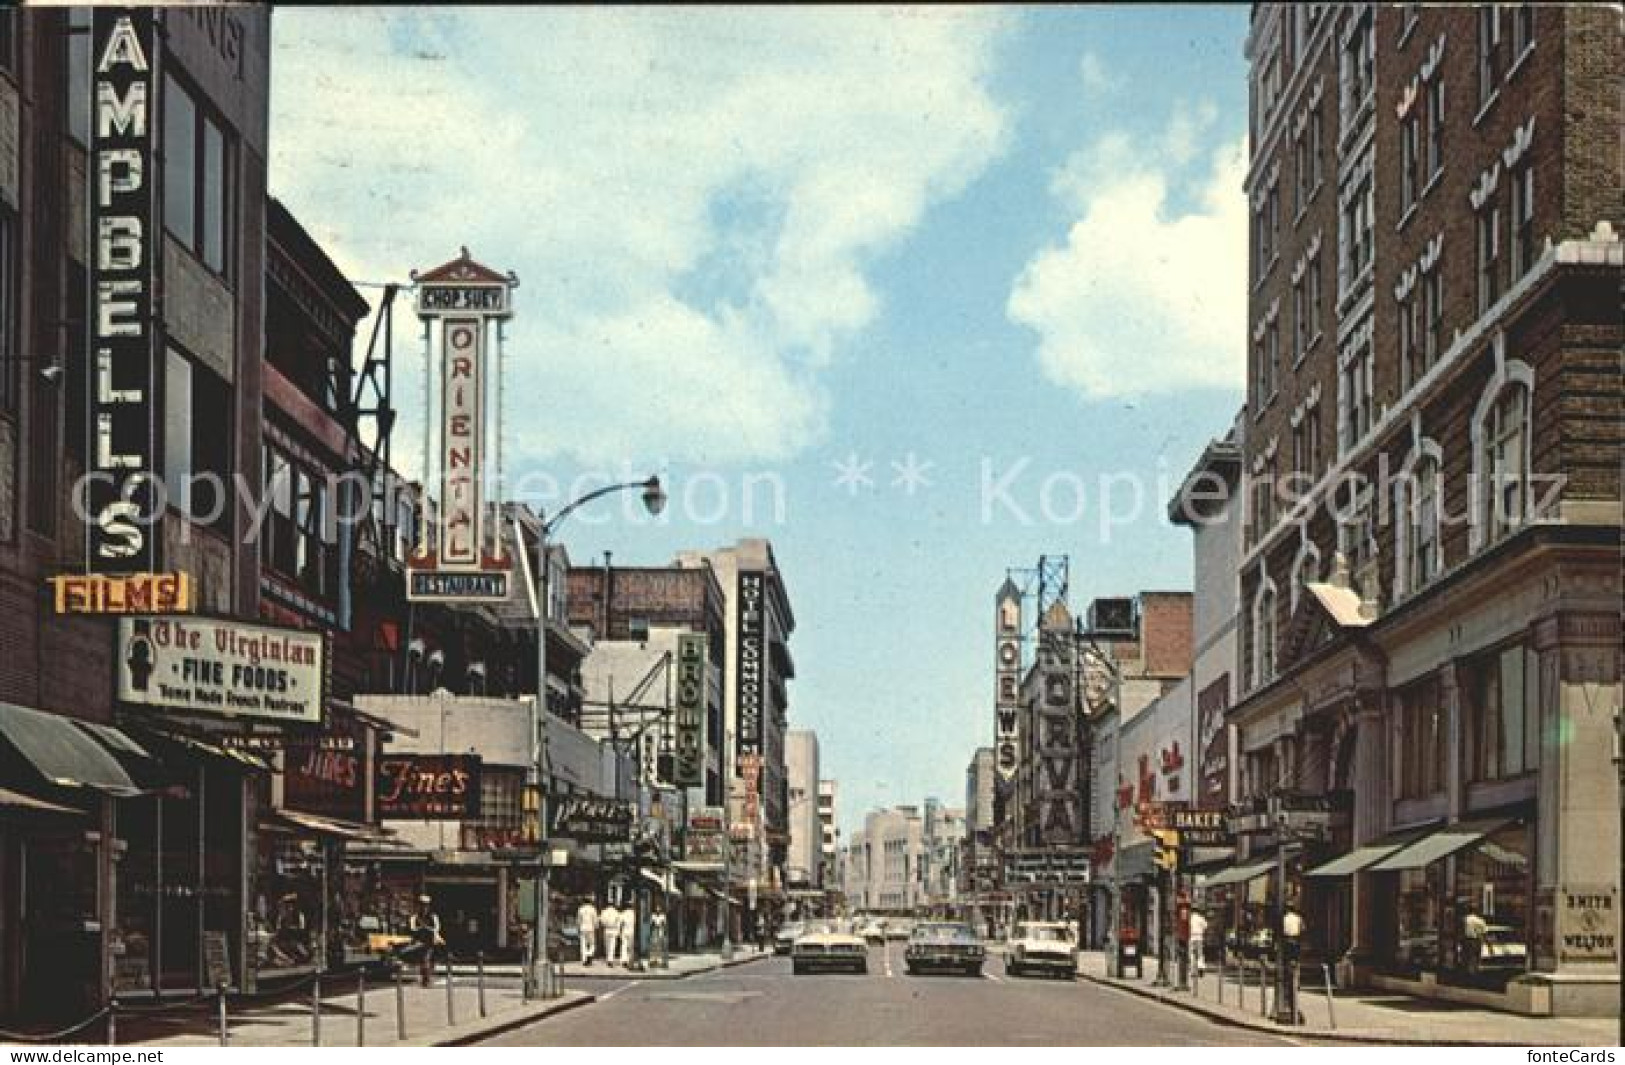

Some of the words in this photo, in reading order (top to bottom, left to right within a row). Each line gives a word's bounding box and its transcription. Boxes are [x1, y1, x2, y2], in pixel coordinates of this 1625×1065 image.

[97, 7, 149, 558] AMPBELL'S
[450, 327, 473, 557] ORIENTAL
[63, 574, 180, 610] FILMS
[412, 573, 505, 596] RESTAURANT
[742, 576, 760, 634] HOTEL
[151, 618, 201, 650] The
[214, 627, 316, 665] Virginian
[183, 656, 224, 686] FINE
[232, 663, 288, 693] FOODS
[1040, 630, 1077, 840] NORVA
[379, 760, 469, 801] Fine's
[1566, 894, 1612, 910] SMITH
[1564, 934, 1614, 953] WELTON
